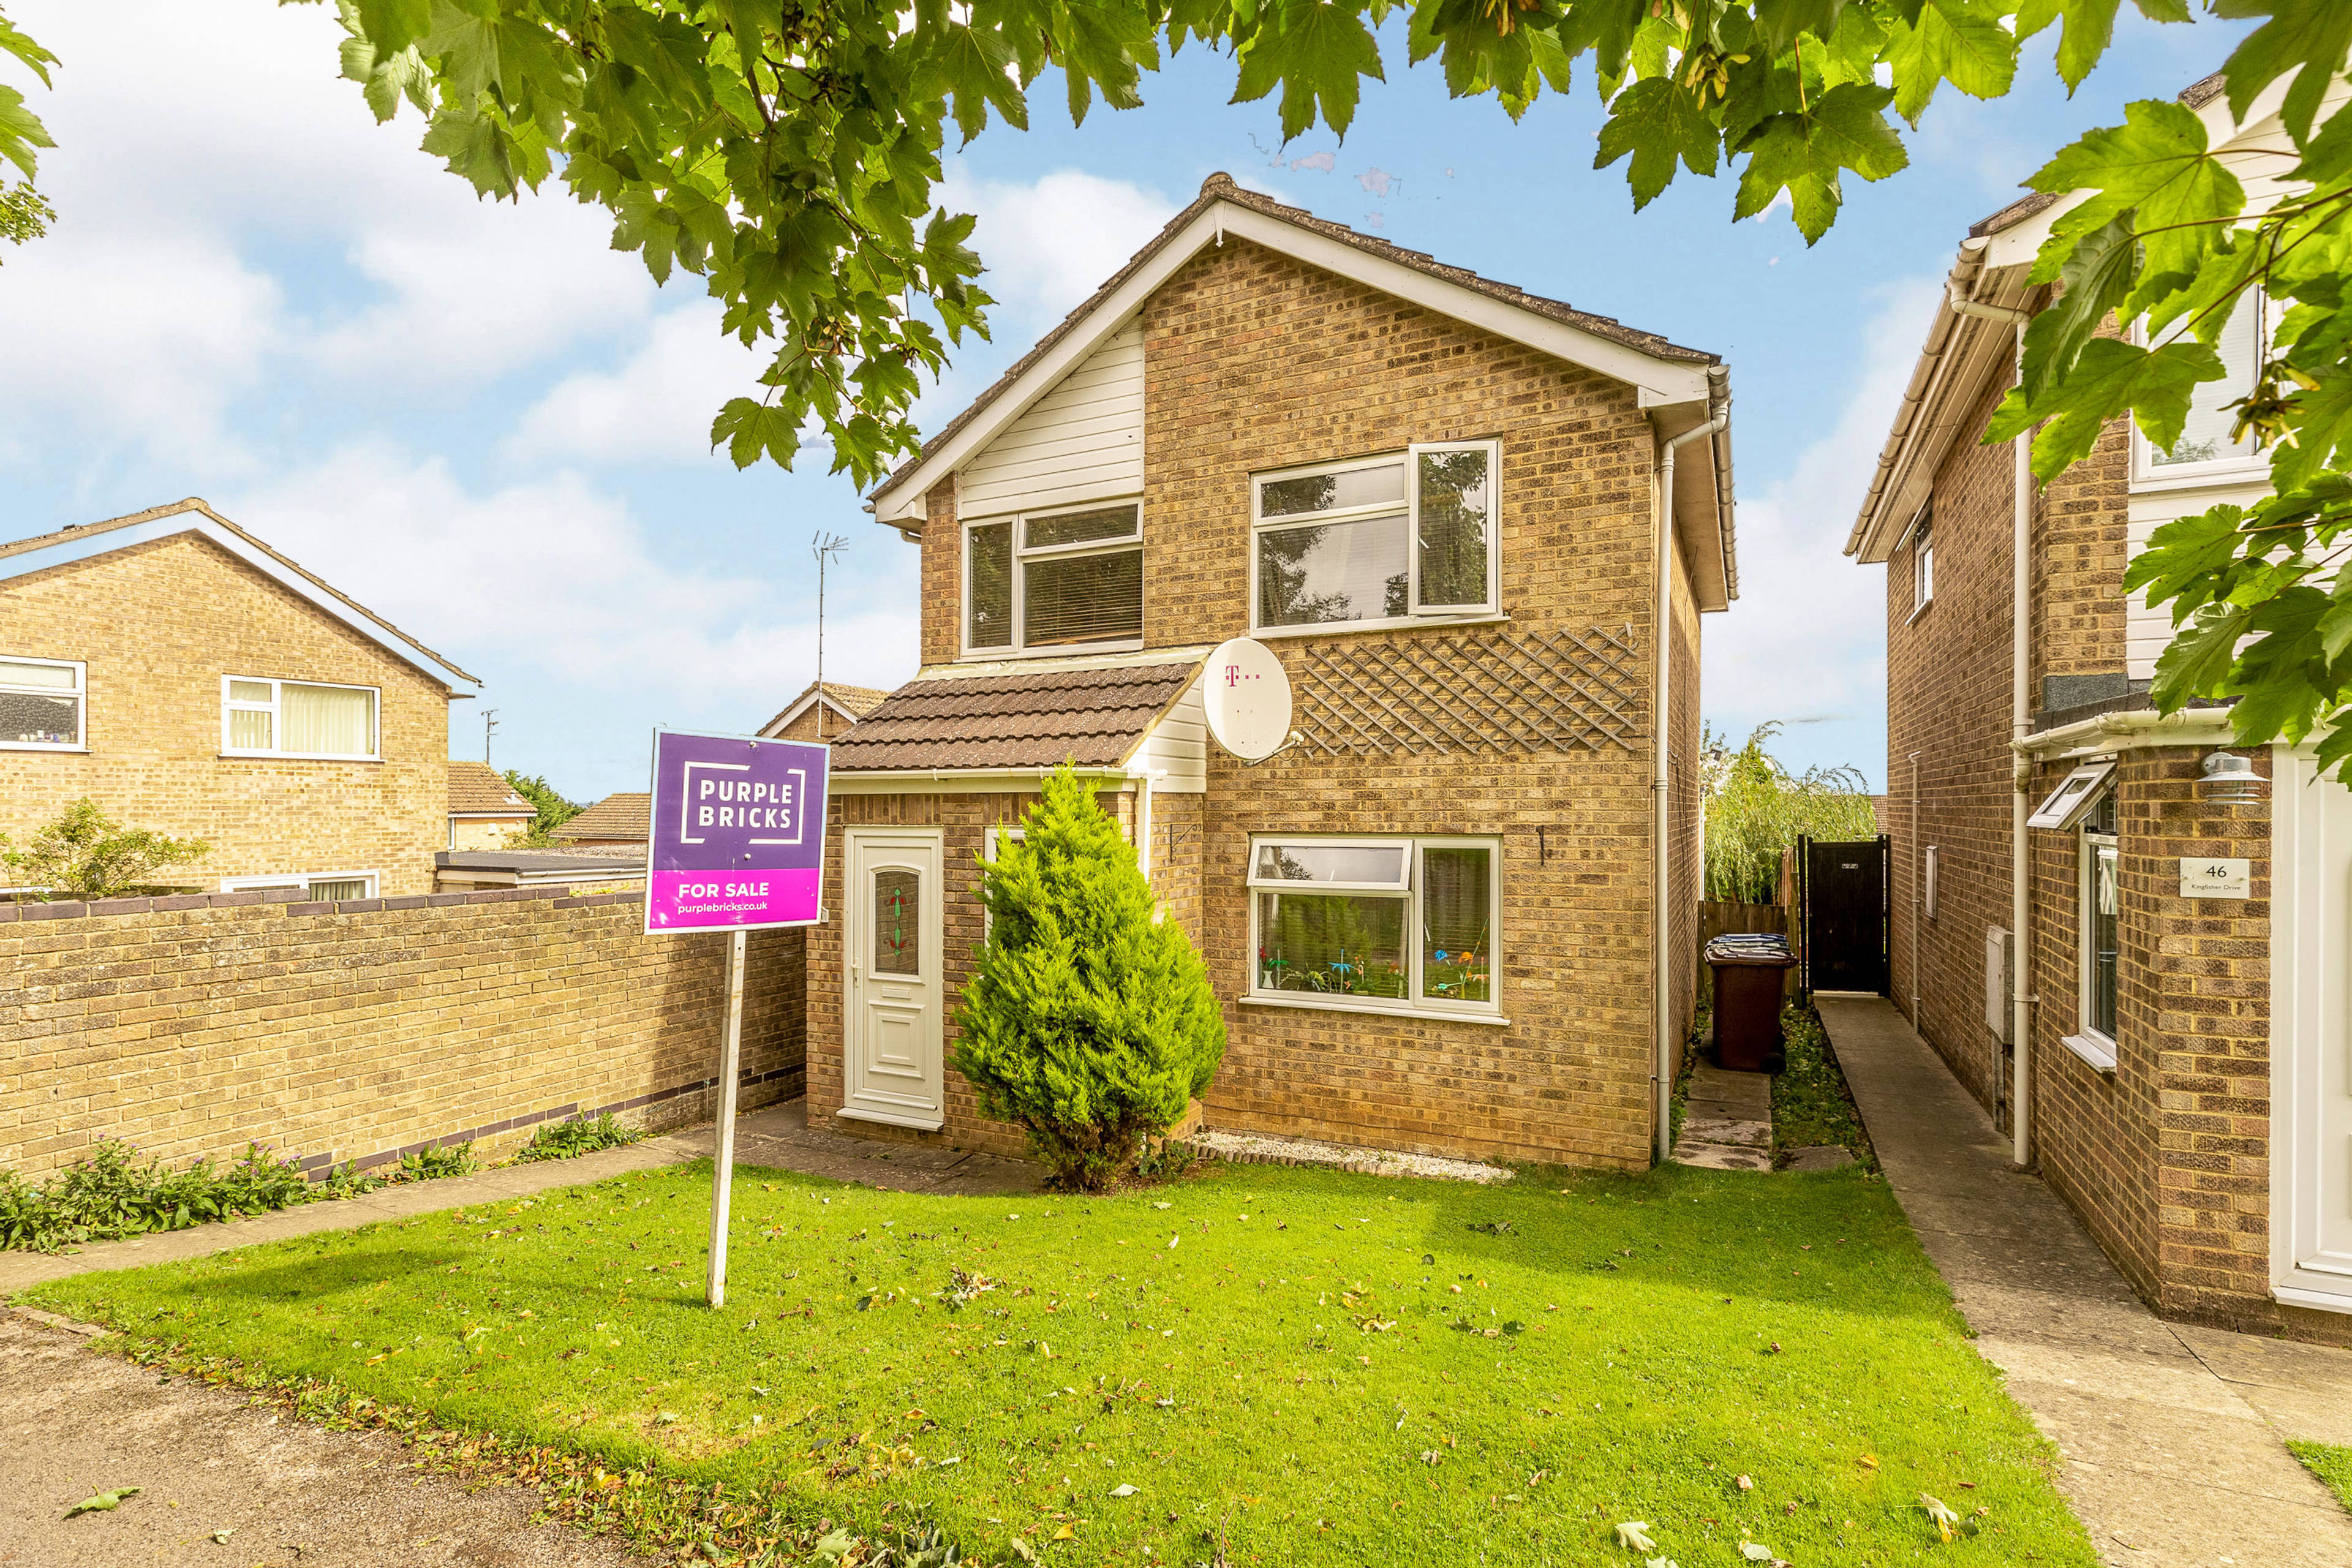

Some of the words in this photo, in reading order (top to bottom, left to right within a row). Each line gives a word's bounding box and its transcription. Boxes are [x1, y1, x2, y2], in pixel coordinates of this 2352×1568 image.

[699, 779, 793, 804] PURPLE
[698, 805, 791, 828] BRICKS
[2206, 865, 2227, 878] 46
[678, 883, 718, 899] FOR
[725, 882, 769, 897] SALE
[677, 902, 767, 915] purplebricks.co.uk
